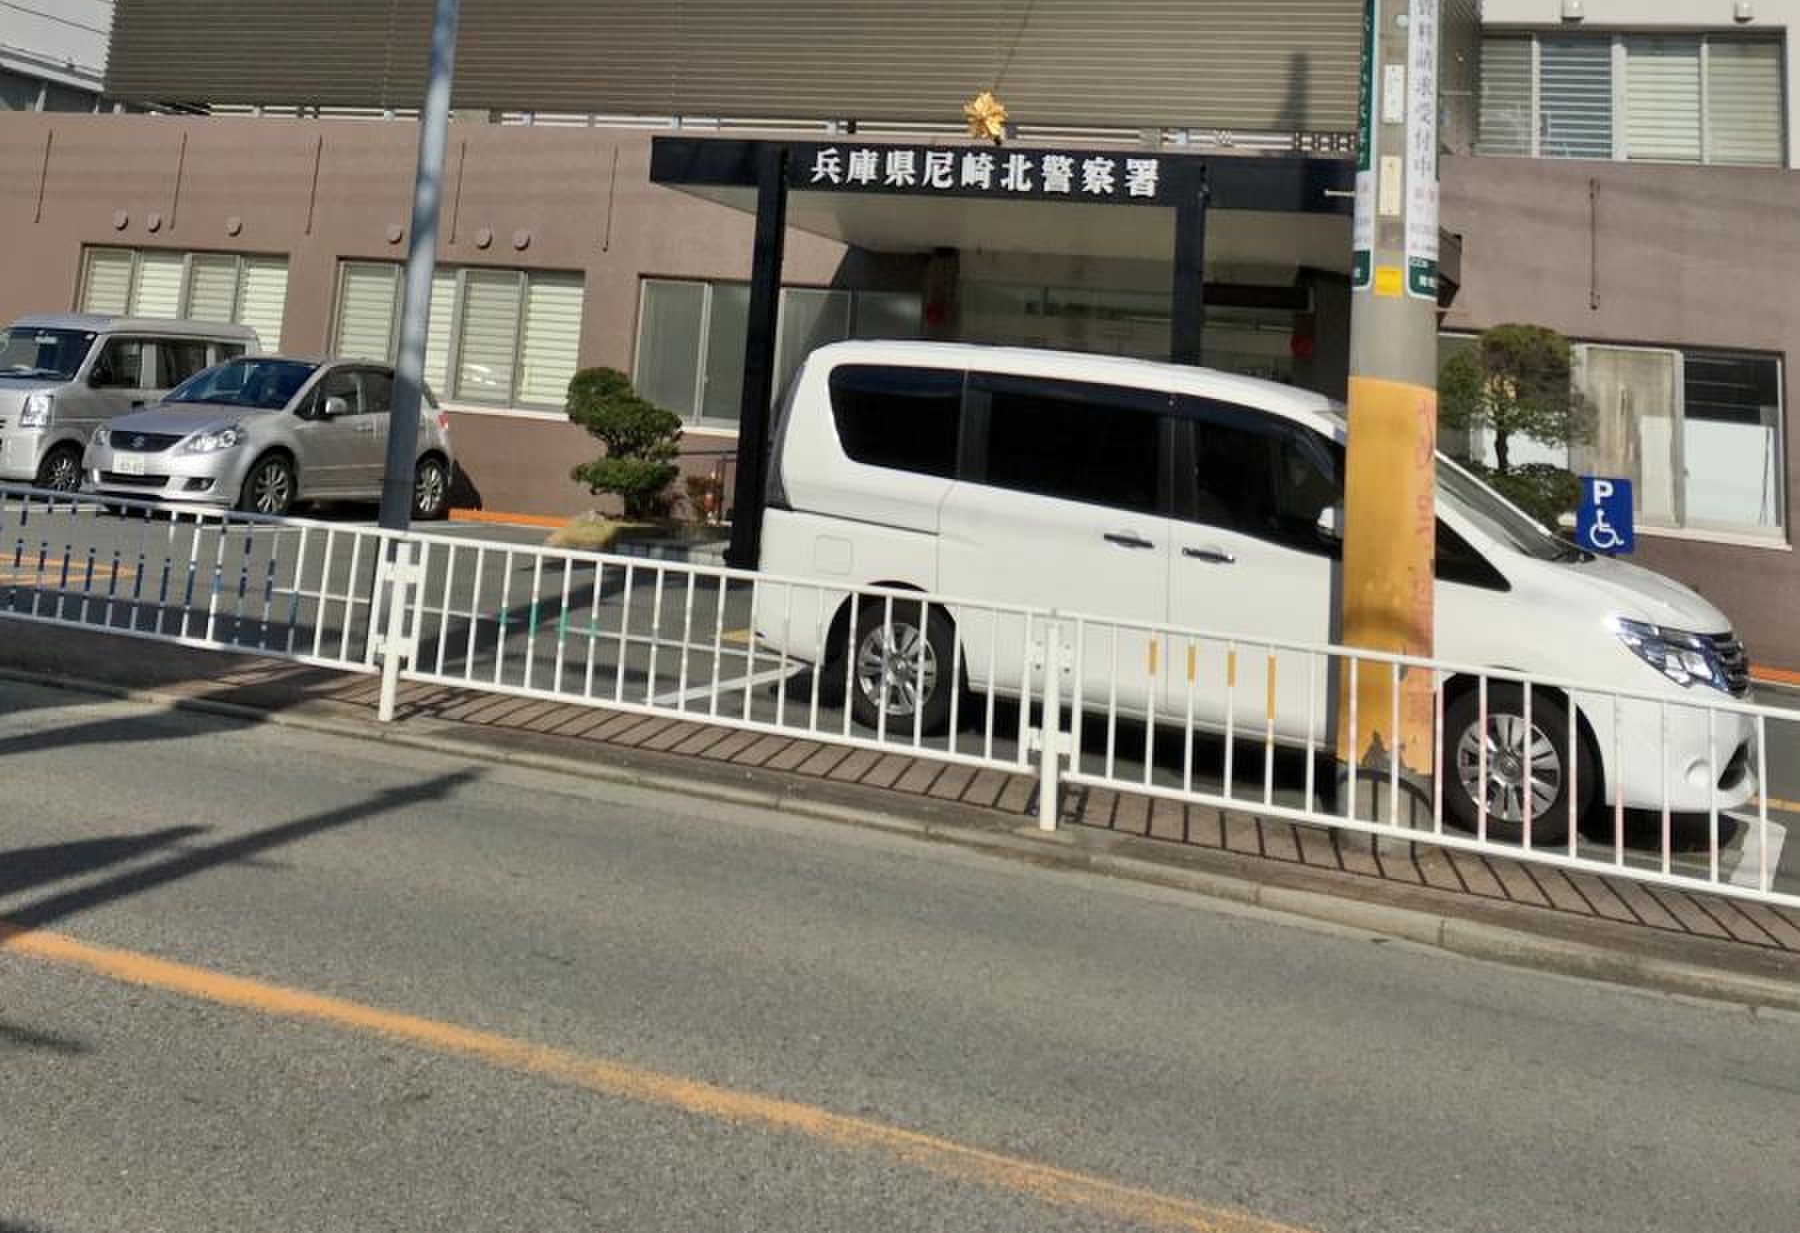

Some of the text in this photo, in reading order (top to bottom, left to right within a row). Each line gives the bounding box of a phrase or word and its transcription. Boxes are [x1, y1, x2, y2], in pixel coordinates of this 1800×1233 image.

[810, 147, 1160, 197] 兵庫県尼崎北警察署
[1593, 479, 1614, 505] P
